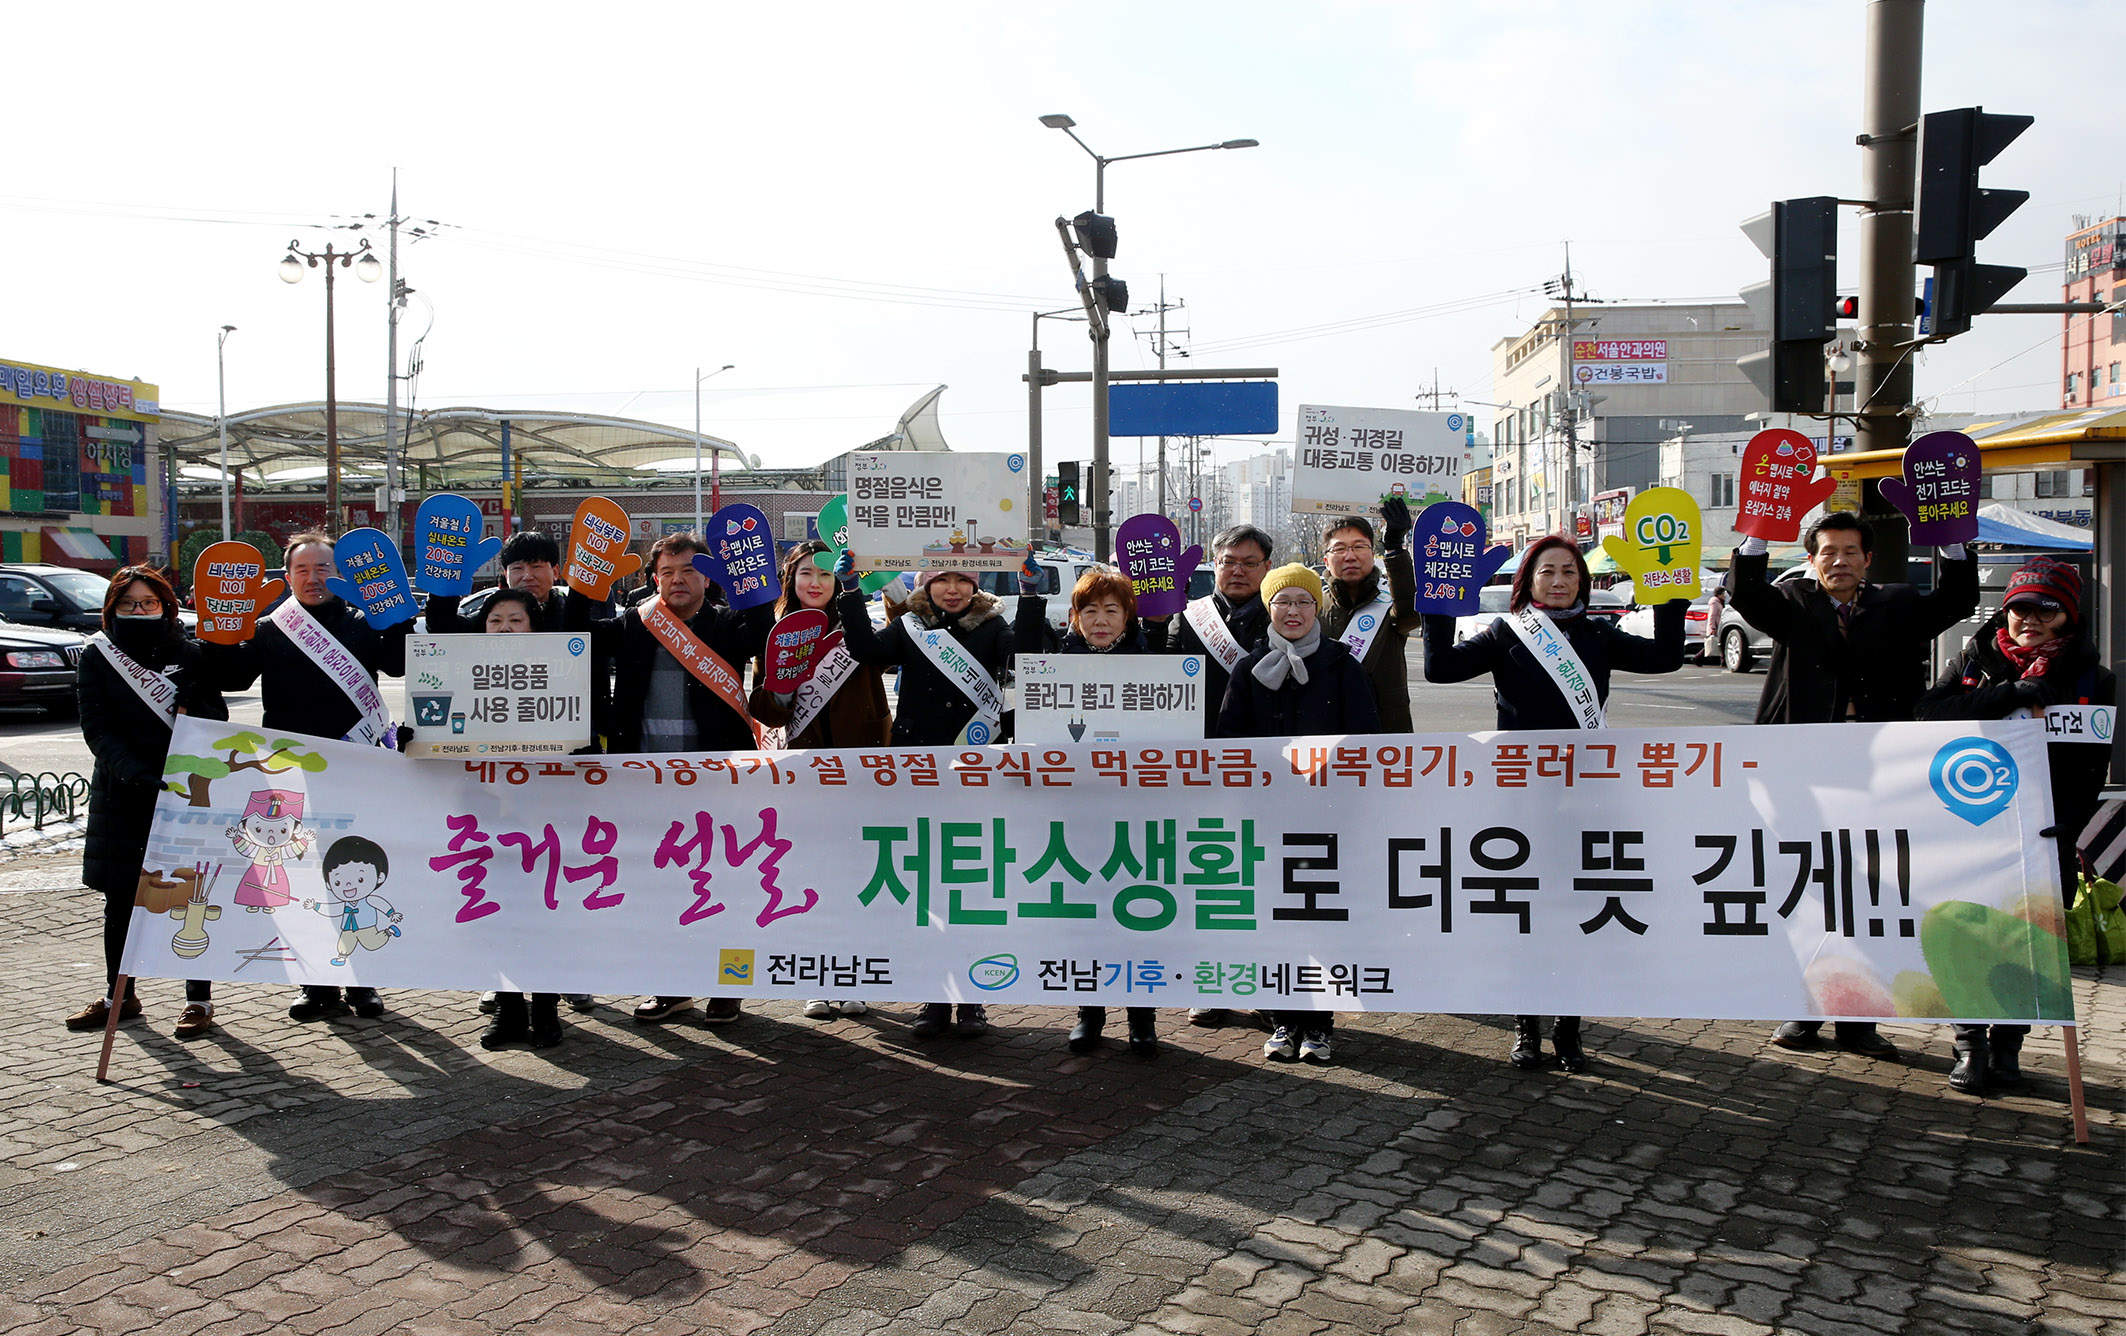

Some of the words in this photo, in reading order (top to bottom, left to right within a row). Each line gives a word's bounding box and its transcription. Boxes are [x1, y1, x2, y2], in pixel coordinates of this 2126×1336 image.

[2075, 233, 2103, 250] HOTEL
[1303, 448, 1374, 472] 대중교통
[1380, 452, 1458, 477] 이용하기!
[1913, 459, 1946, 480] 안쓰는
[855, 476, 943, 500] 명절음식은
[1749, 480, 1772, 497] 에너지
[1772, 483, 1791, 500] 절약
[1915, 482, 1938, 501] 전기
[1939, 478, 1971, 498] 코드는
[855, 505, 890, 528] 먹을
[897, 505, 956, 528] 만큼만!
[1745, 500, 1774, 517] 온실가스
[1775, 505, 1792, 521] 감축
[1917, 500, 1969, 523] 뽑아주세요
[429, 515, 460, 532] 겨울철
[583, 512, 625, 544] 비닐봉투
[1637, 513, 1690, 545] CO2
[427, 531, 467, 549] 실내온도
[586, 533, 608, 553] NO!
[1126, 538, 1153, 558] 안쓰는
[207, 562, 260, 578] 비닐봉투
[345, 549, 374, 570] 겨울철
[726, 556, 769, 578] 체감온도
[884, 559, 911, 568] 전라남도
[1129, 559, 1147, 577] 전기
[1149, 556, 1175, 573] 코드는
[1424, 561, 1472, 579] 체감온도
[353, 562, 391, 585] 실내온도
[424, 563, 462, 582] 건강하게
[574, 563, 598, 586] YES!
[1643, 569, 1671, 586] 저탄소
[1673, 568, 1692, 585] 생활
[219, 580, 245, 595] NO!
[367, 595, 406, 616] 건강하게
[215, 616, 243, 632] YES!
[472, 664, 549, 691] 일회용품
[1024, 682, 1075, 710] 플러그
[1081, 682, 1115, 710] 뽑고
[1121, 682, 1196, 711] 출발하기!
[470, 696, 509, 723] 사용
[517, 696, 580, 722] 줄이기!
[442, 744, 470, 753] 전라남도
[808, 755, 848, 786] 설
[859, 752, 937, 787] 명절
[953, 750, 1075, 787] 음식은
[1091, 748, 1272, 787] 먹을만큼,
[1290, 744, 1474, 788] 내복입기,
[1491, 743, 1621, 788] 플러그
[1636, 742, 1723, 788] 뽑기
[429, 813, 625, 924] 즐거운
[857, 816, 1349, 932] 저탄소생활로
[1387, 826, 1540, 935] 더욱
[1572, 830, 1654, 936] 뜻
[1691, 828, 1916, 938] 깊게!!
[767, 954, 893, 987] 전라남도
[983, 968, 1006, 977] KCEN
